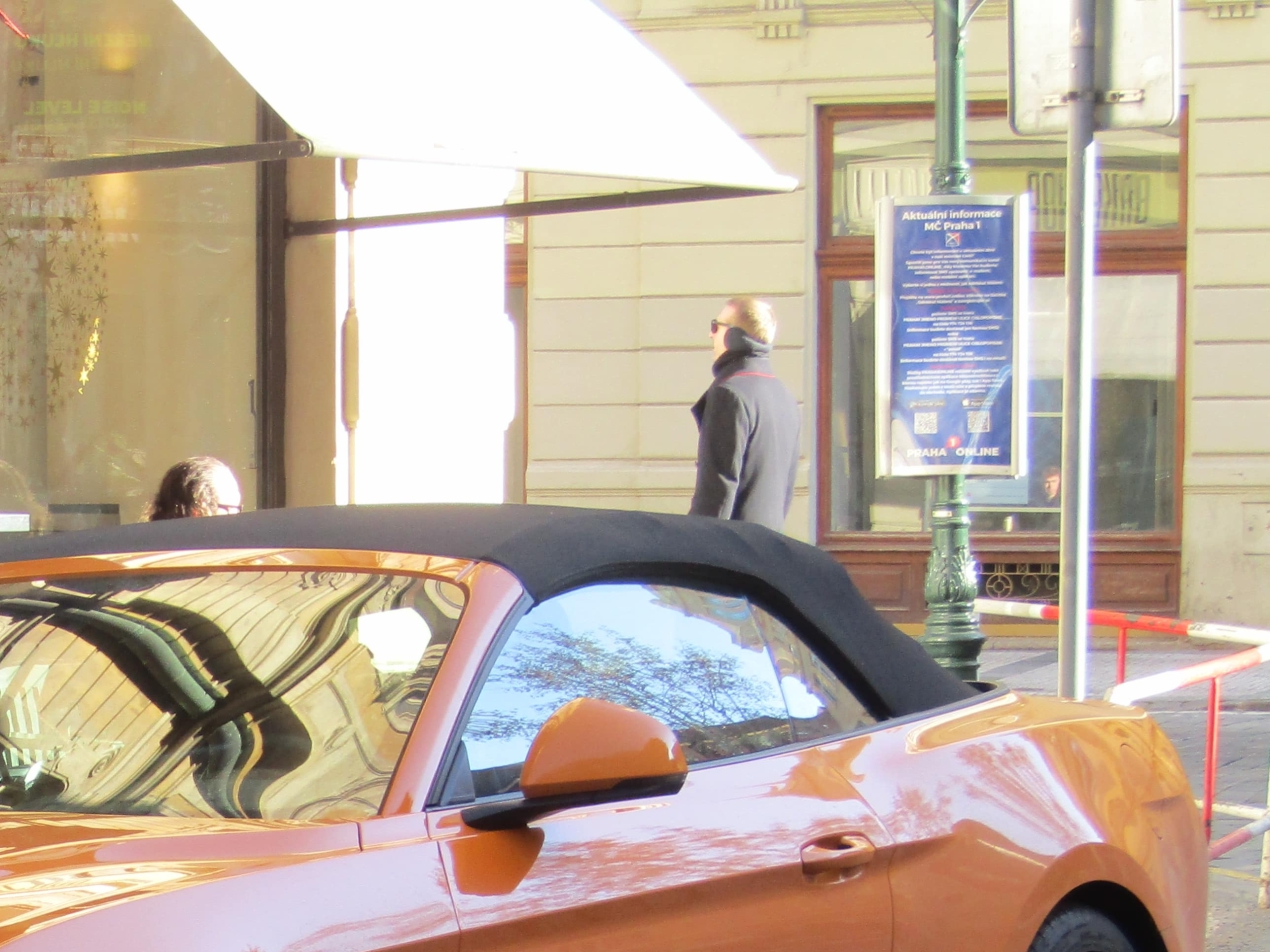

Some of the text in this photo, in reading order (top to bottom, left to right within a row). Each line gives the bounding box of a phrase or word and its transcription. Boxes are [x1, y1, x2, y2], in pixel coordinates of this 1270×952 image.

[901, 209, 1003, 221] Aktuální informace
[924, 220, 981, 231] MČ Praha 1
[906, 447, 1000, 458] PRAHA ONLINE
